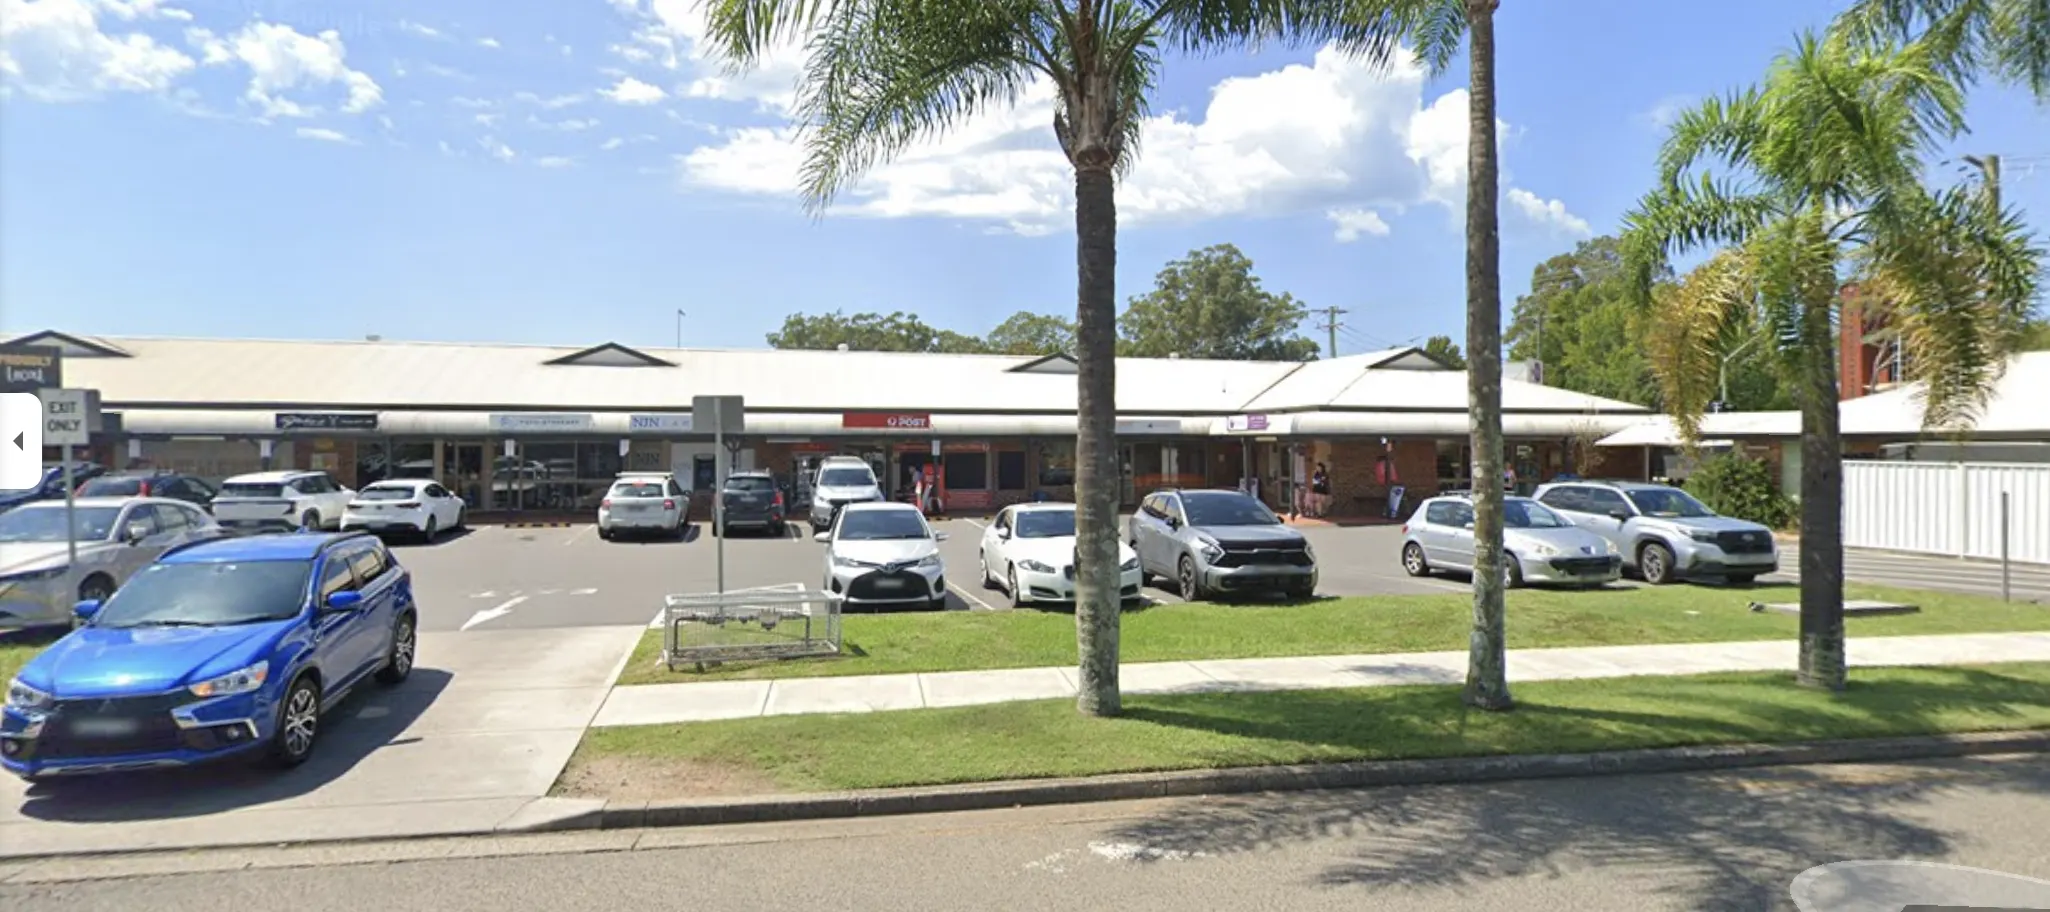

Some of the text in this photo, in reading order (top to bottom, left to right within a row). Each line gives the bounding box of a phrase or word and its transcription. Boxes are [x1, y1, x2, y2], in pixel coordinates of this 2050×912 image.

[48, 401, 78, 413] EXIT
[47, 419, 82, 432] ONLY
[633, 417, 660, 428] NJN
[898, 417, 926, 426] POST
